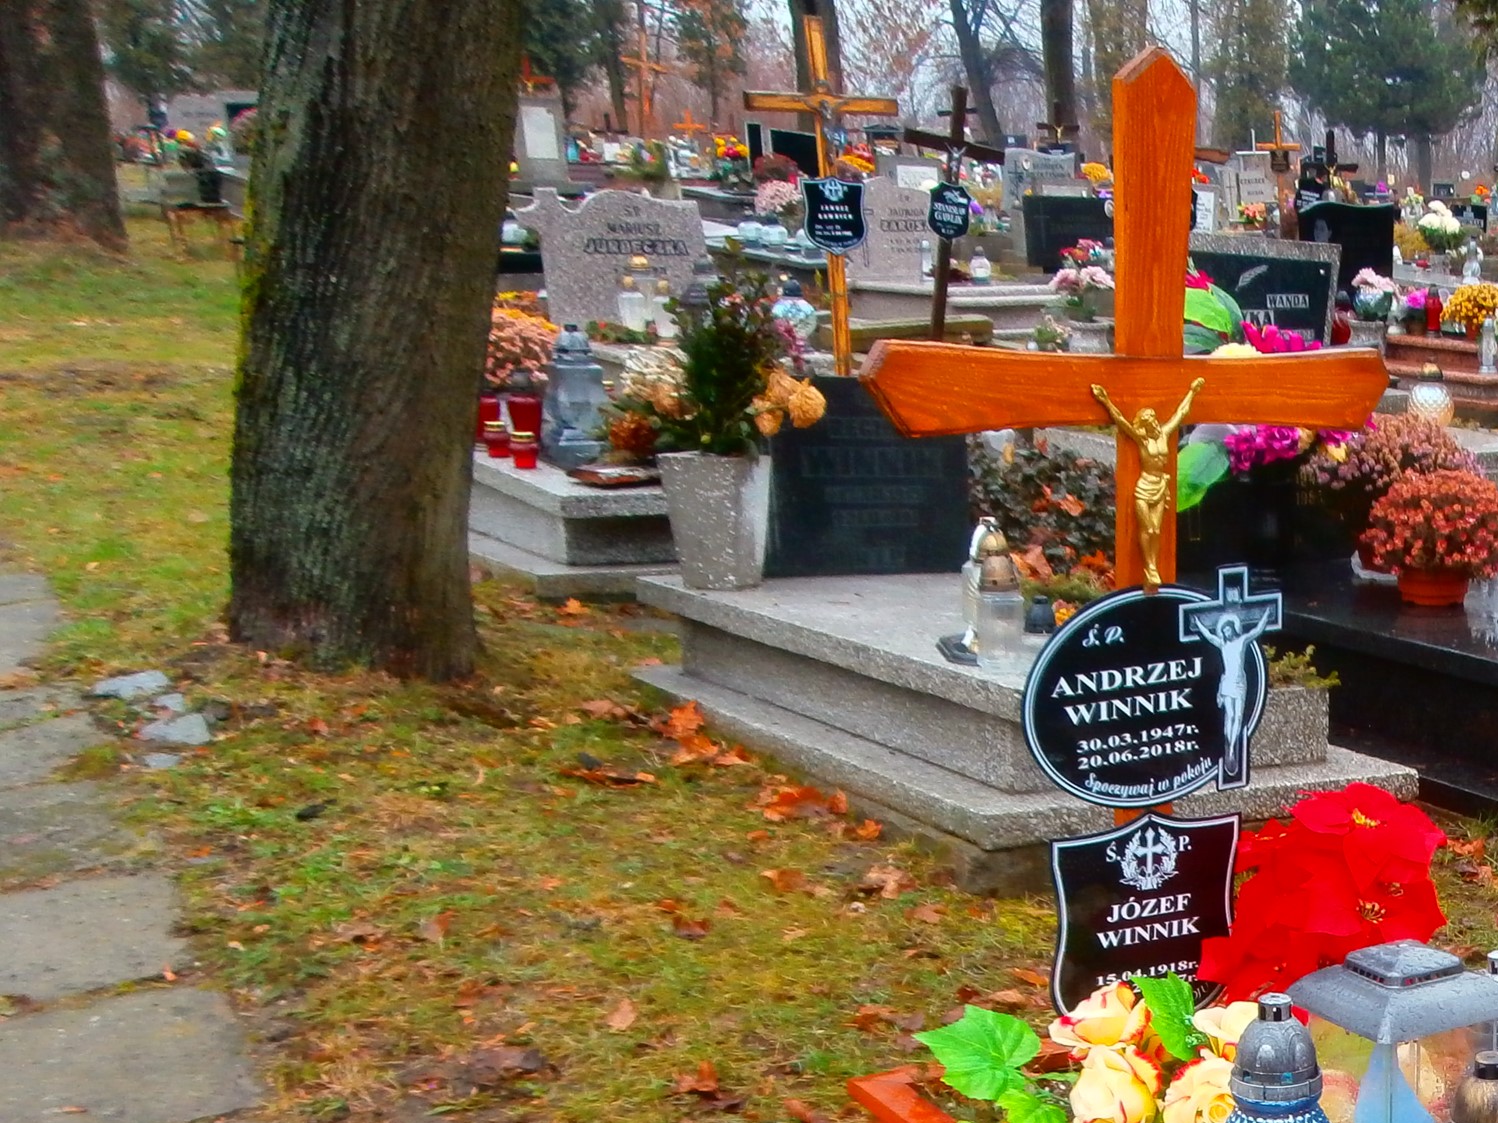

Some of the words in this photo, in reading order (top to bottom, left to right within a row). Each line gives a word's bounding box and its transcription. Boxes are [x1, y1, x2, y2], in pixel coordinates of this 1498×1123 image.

[1266, 294, 1309, 308] WANDA
[1050, 657, 1203, 698] ANDRZEJ
[1064, 688, 1193, 726] WINNIK
[1076, 723, 1199, 753] 30.03.1947r.
[1077, 740, 1200, 770] 20.06.2018r.
[1084, 772, 1155, 798] Spoczywaj
[1158, 778, 1170, 791] w
[1173, 756, 1213, 795] pokoju
[1179, 835, 1192, 851] P.
[1106, 893, 1192, 923] JÓZEF
[1096, 916, 1200, 949] WINNIK
